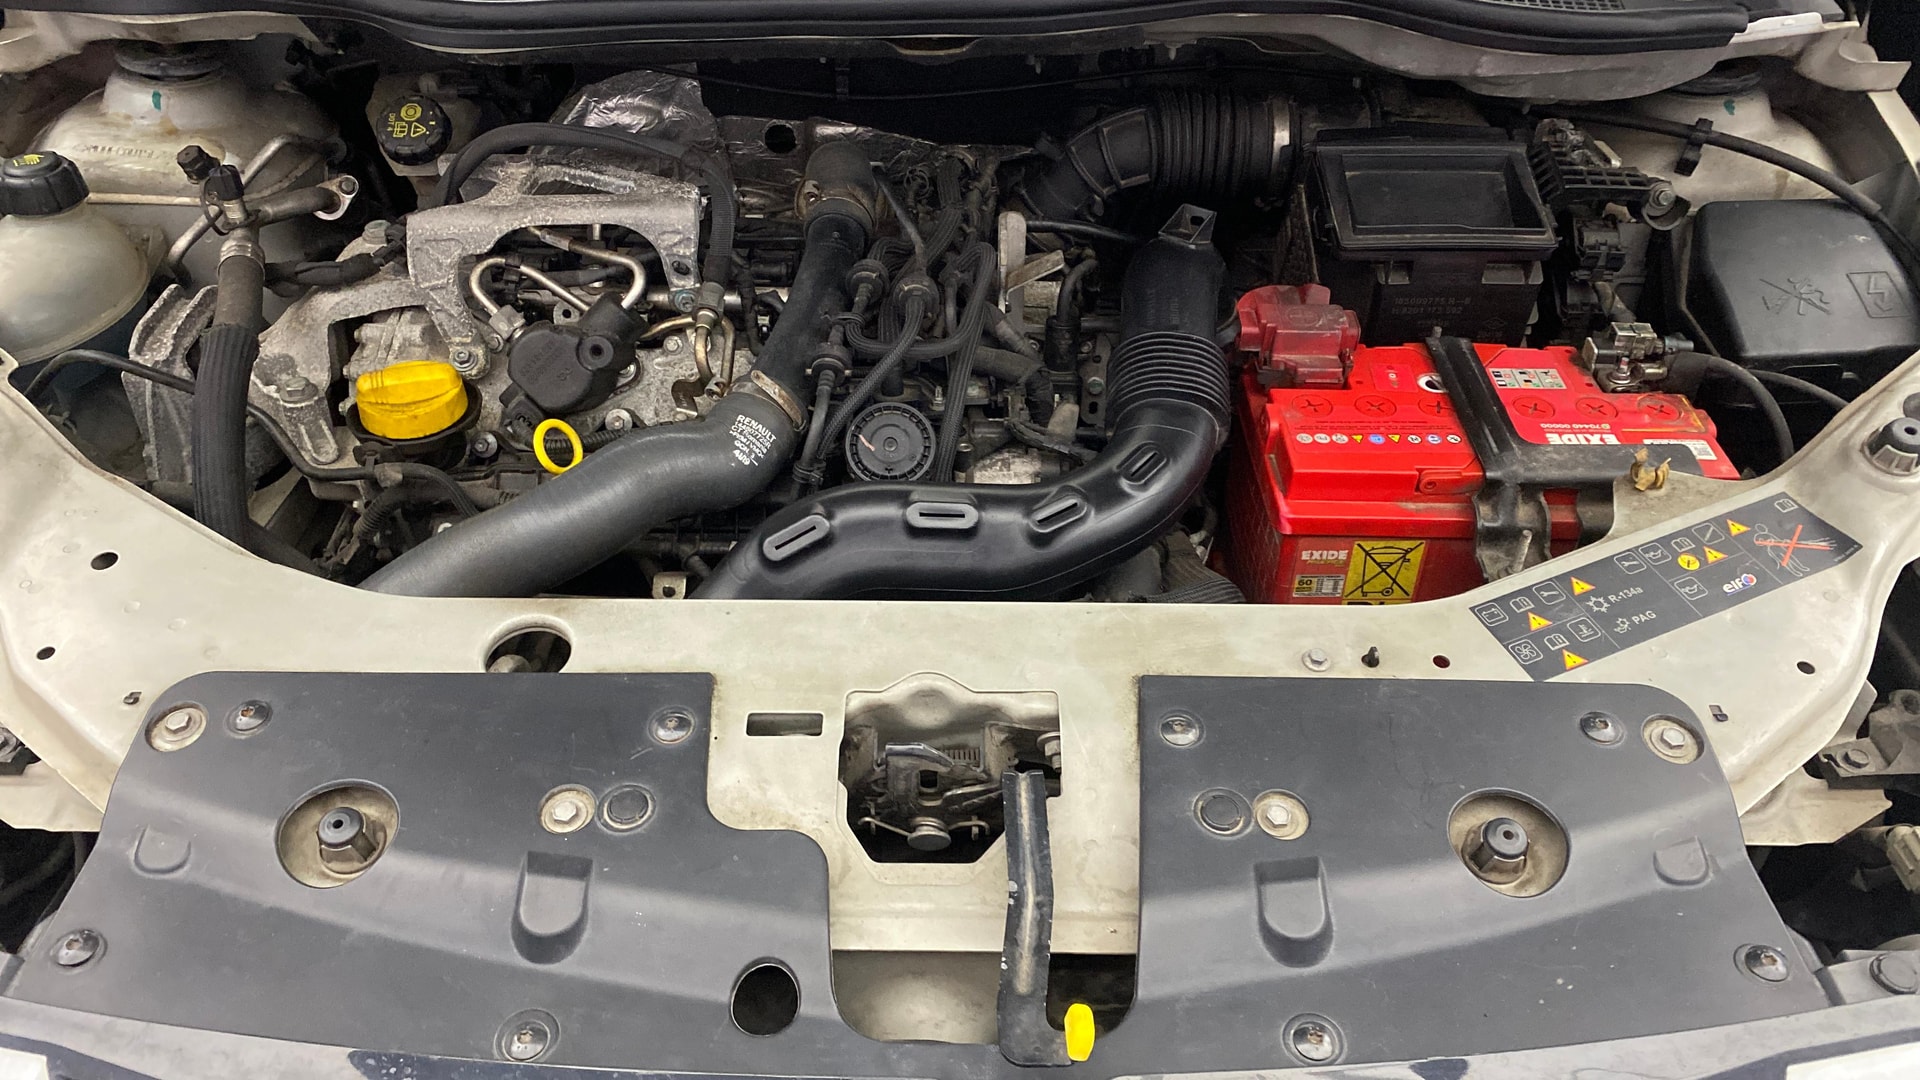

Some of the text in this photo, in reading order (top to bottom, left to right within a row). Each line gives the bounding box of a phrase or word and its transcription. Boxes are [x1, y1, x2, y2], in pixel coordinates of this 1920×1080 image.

[736, 414, 777, 443] RENAULT
[1545, 433, 1621, 445] EXIDE
[1301, 550, 1349, 560] EXIDE
[1608, 587, 1644, 604] R-134a
[1632, 611, 1657, 625] PAG
